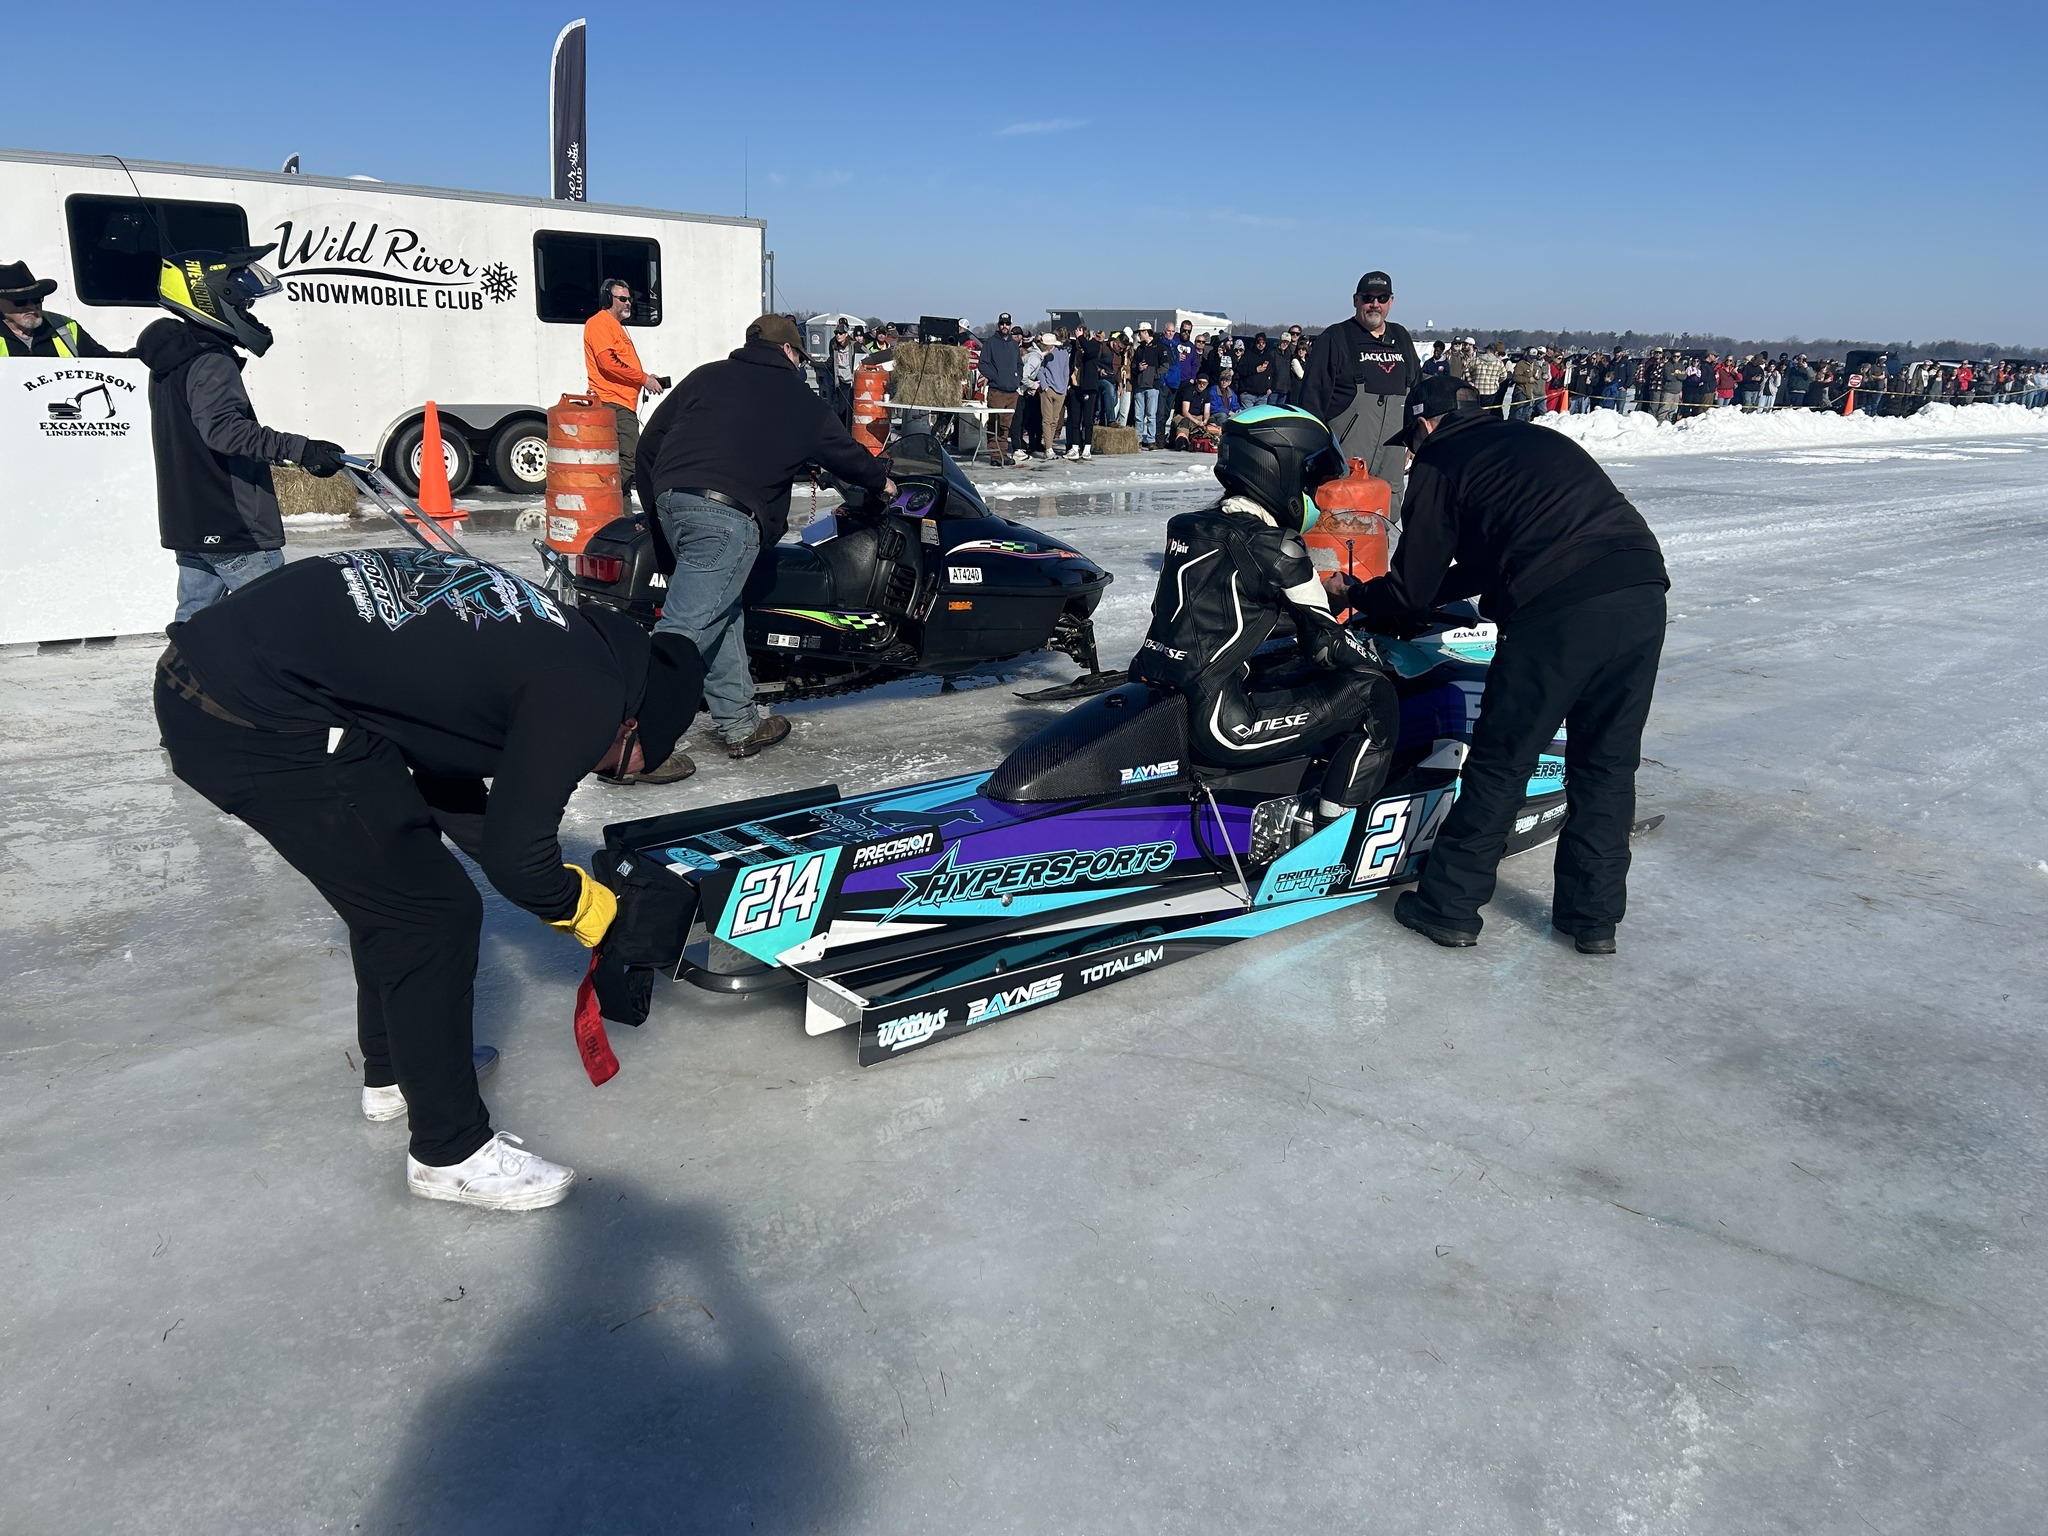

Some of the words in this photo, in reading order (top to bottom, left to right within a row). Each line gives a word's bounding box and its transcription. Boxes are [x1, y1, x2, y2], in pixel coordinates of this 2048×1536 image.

[274, 221, 378, 269] Wild
[383, 228, 478, 277] River
[287, 281, 428, 308] SNOWMOBILE
[435, 290, 483, 310] CLUB
[23, 375, 53, 391] R.E.
[54, 370, 137, 393] PETERSON
[39, 422, 131, 430] EXCAVATING
[952, 568, 980, 581] AT4240
[1119, 760, 1179, 781] BAYNES
[853, 832, 934, 863] PRECISION
[920, 841, 1177, 906] HYPERSPORTS
[1274, 875, 1333, 893] wraps
[729, 853, 825, 939] 214
[1080, 945, 1164, 984] TOTALSIM
[966, 973, 1064, 1019] BAYNES
